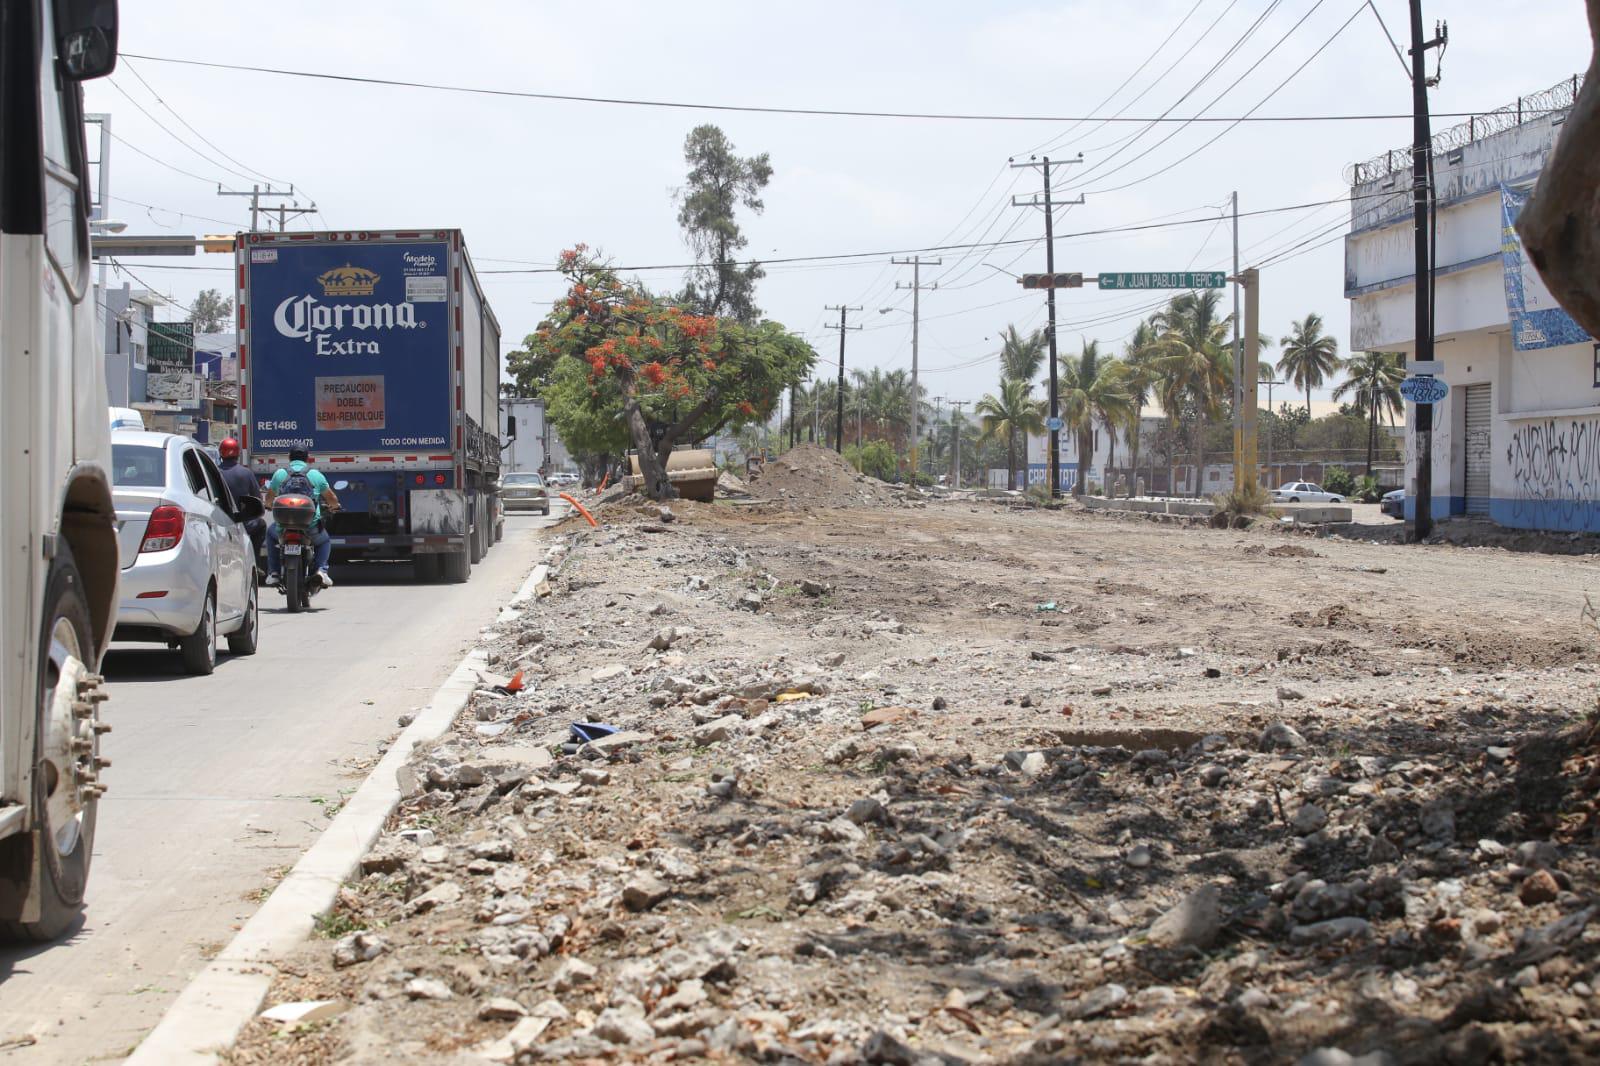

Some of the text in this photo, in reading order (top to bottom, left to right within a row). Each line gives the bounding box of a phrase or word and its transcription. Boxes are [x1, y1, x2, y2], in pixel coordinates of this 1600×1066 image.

[1129, 274, 1149, 288] JUAN
[1152, 274, 1177, 288] PABLO
[1191, 273, 1213, 287] TEPIC
[273, 294, 418, 343] Corona
[315, 333, 380, 355] Extra
[323, 383, 377, 393] PRECAUCION
[337, 397, 364, 407] DOBLE
[316, 411, 384, 422] SEMI-REMOLQUE
[257, 421, 297, 431] RE1486
[380, 436, 446, 446] TODO CON MEDIDA
